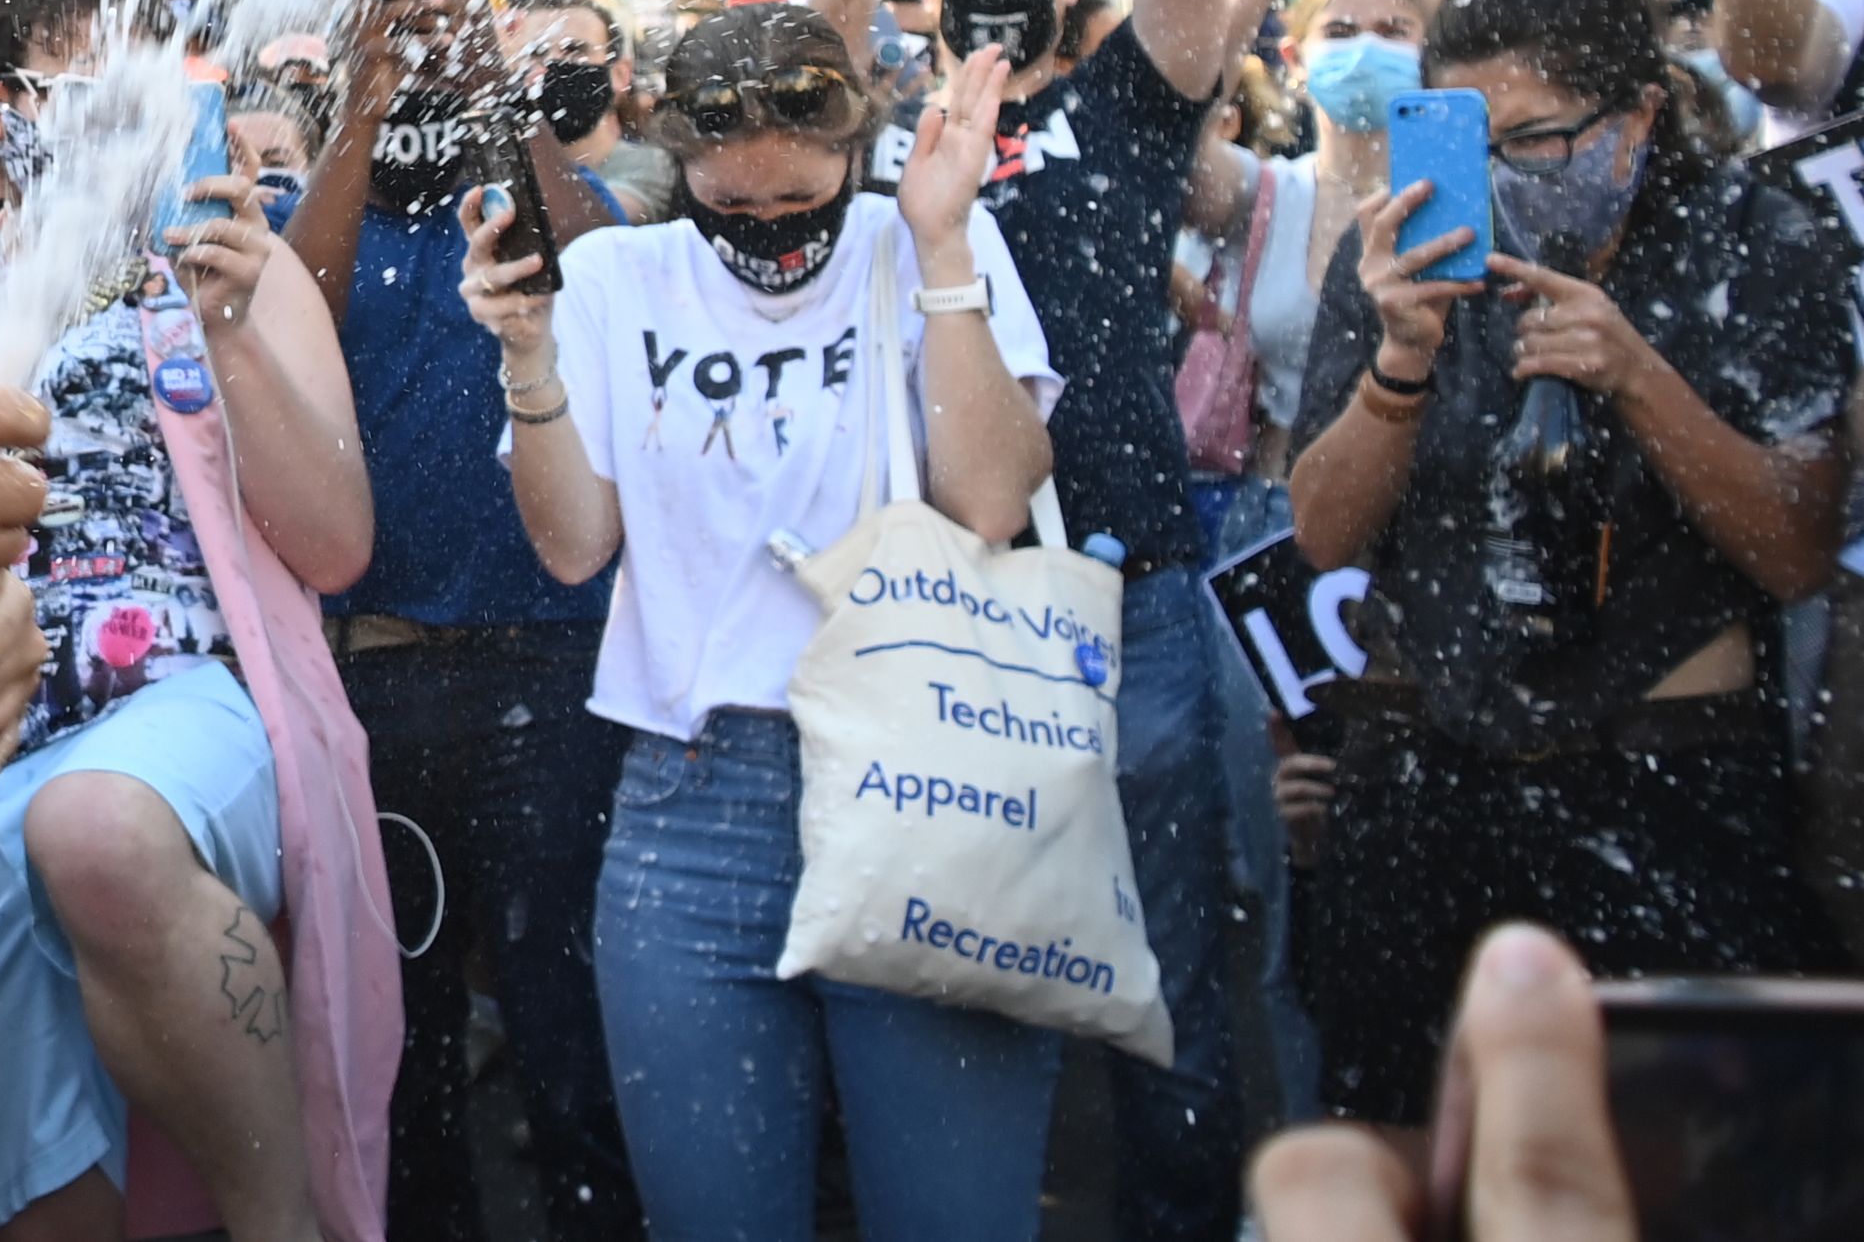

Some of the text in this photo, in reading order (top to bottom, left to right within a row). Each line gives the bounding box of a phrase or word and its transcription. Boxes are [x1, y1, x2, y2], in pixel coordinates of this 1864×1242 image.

[642, 325, 858, 401] VOTE
[856, 760, 1037, 831] Apparel
[901, 896, 1116, 995] Recreation
